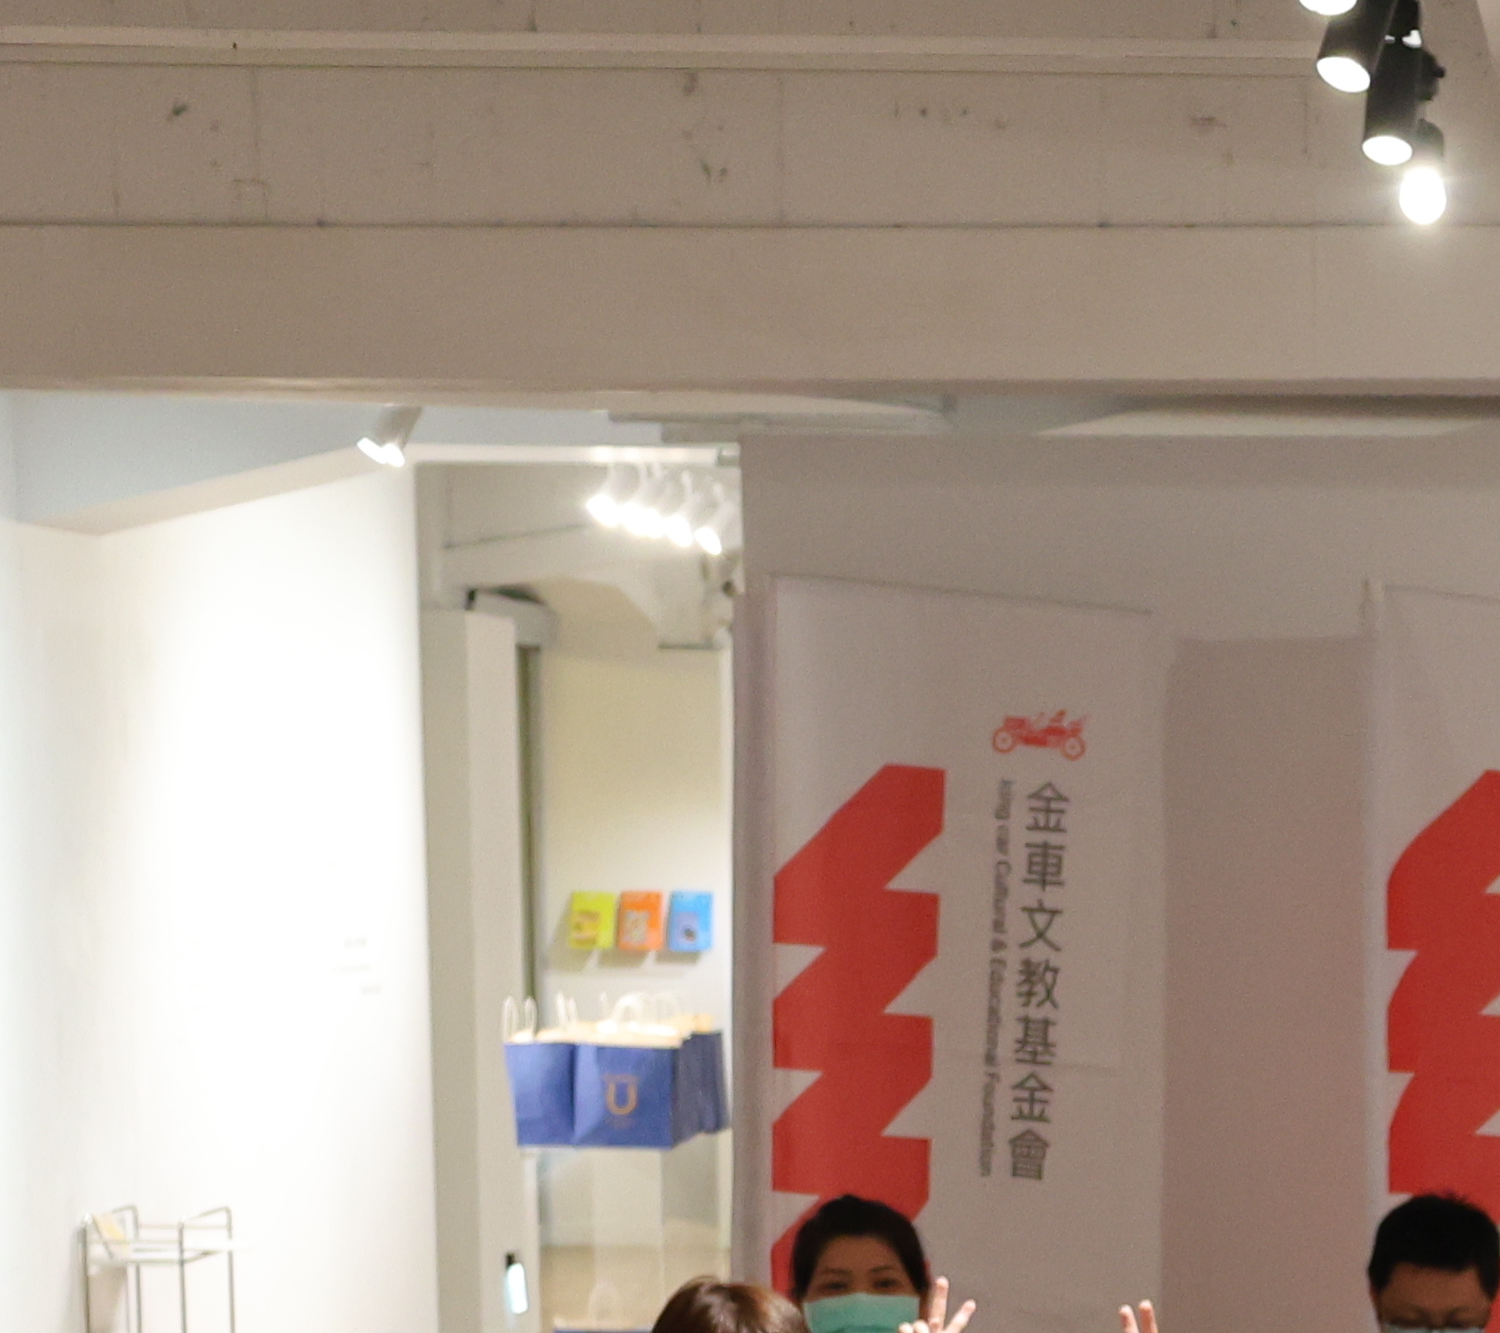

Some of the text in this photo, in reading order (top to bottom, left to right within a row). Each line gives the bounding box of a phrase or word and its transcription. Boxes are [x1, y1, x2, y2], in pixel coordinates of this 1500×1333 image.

[1009, 781, 1070, 1181] 金車文教基金會
